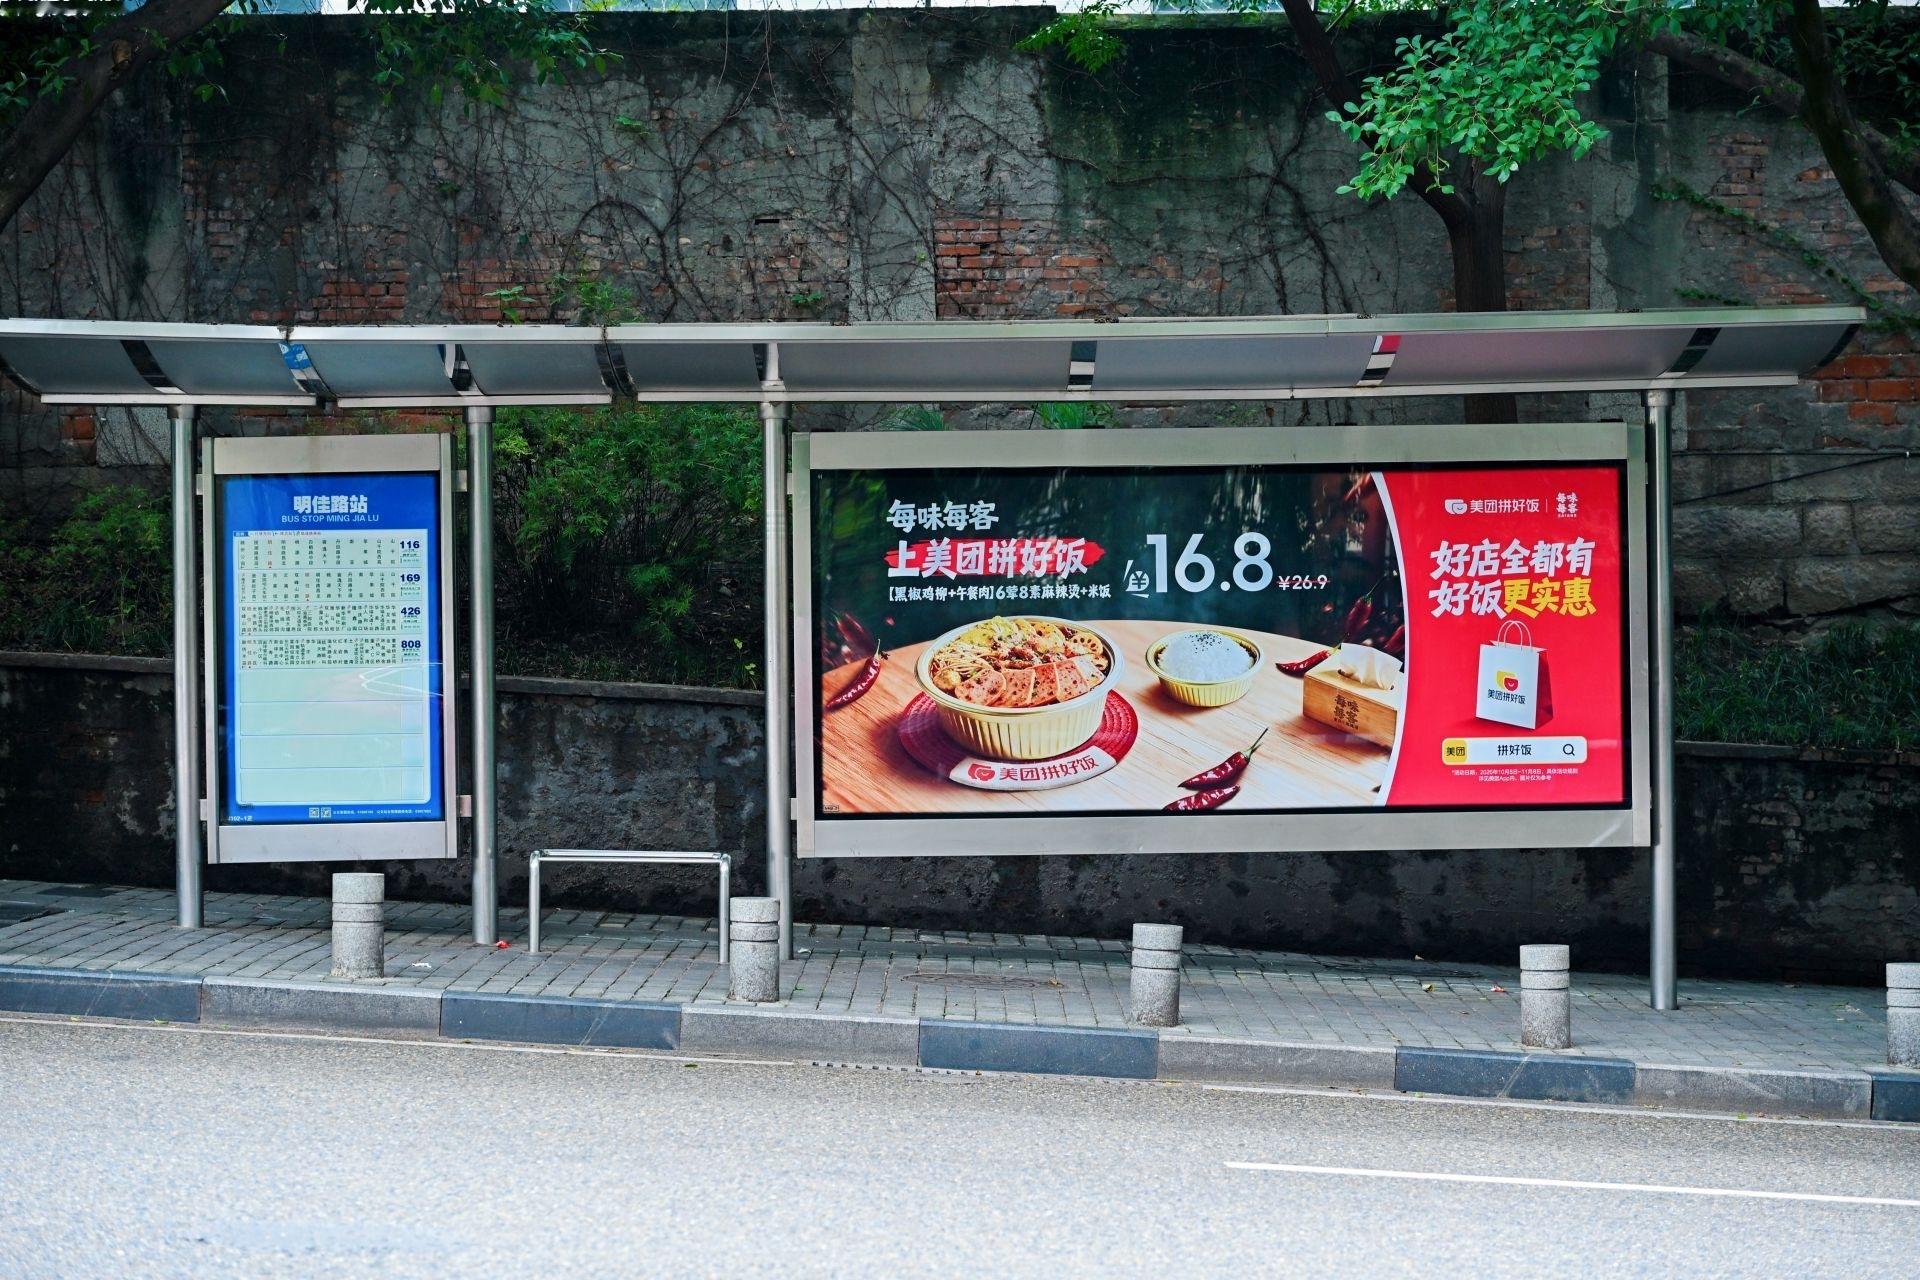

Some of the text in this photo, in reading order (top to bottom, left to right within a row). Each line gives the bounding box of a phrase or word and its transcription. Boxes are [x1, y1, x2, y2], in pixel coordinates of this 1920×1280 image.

[293, 495, 368, 514] 明佳路站
[1470, 498, 1540, 514] 美团拼好饭
[281, 514, 379, 523] BUS STOP MING JIA LU
[886, 499, 1000, 533] 每味每客
[399, 540, 420, 549] 116
[887, 536, 1088, 580] 上美团拼好饭
[1429, 536, 1596, 580] 好店全都有
[400, 573, 421, 582] 169
[1428, 576, 1597, 619] 好饭更实惠
[400, 607, 421, 615] 426
[401, 640, 421, 648] 808
[1487, 688, 1526, 705] 美团拼好饭
[1446, 746, 1466, 757] 美团
[1497, 744, 1532, 756] 拼好饭
[999, 755, 1100, 781] 美团拼好饭
